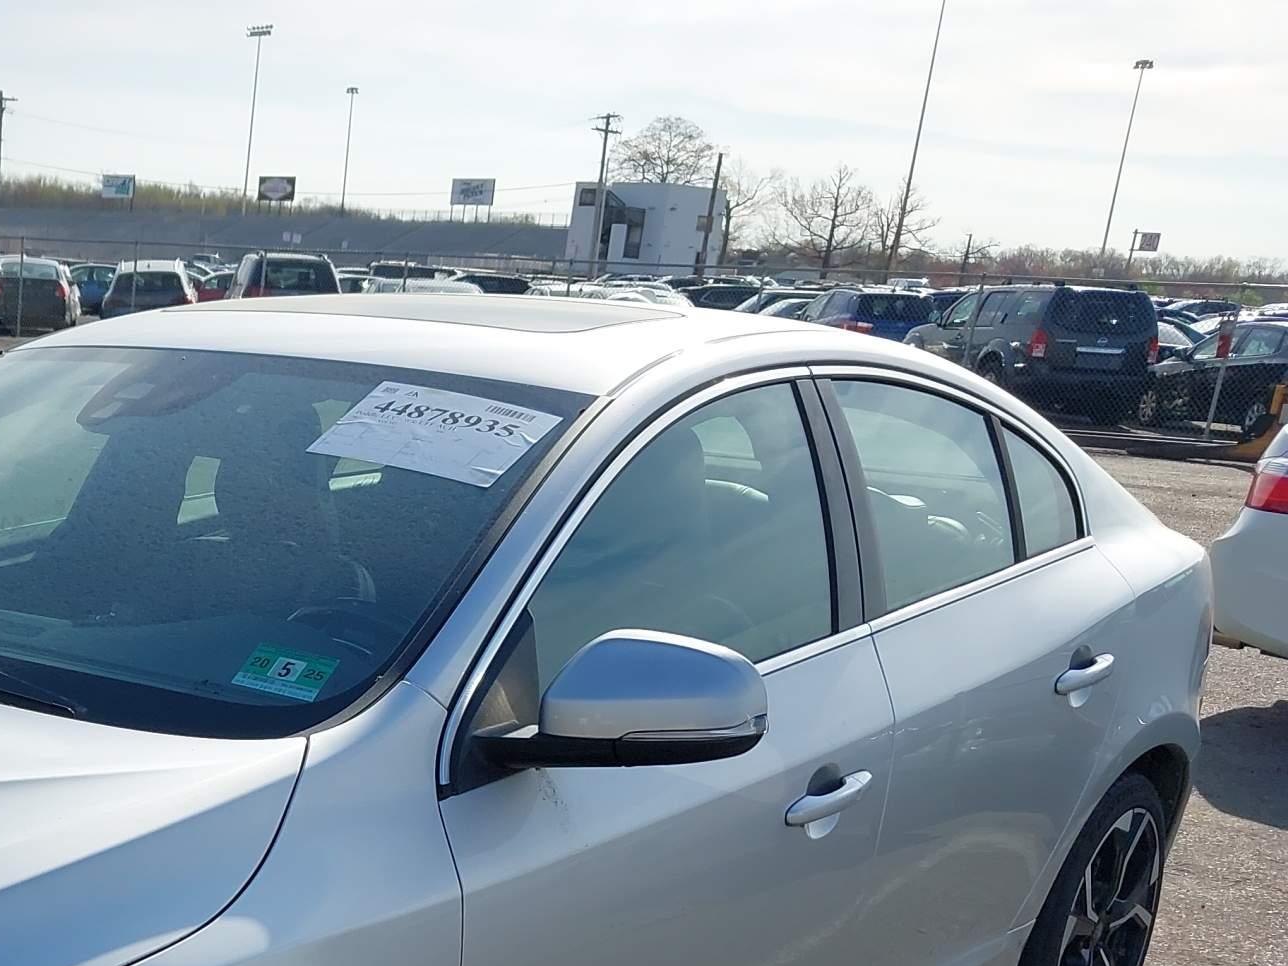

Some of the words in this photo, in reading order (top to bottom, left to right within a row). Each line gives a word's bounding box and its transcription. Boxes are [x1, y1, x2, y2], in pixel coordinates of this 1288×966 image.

[373, 399, 521, 438] 44878935
[249, 656, 271, 669] 20
[277, 661, 296, 678] 5
[303, 668, 325, 681] 25
